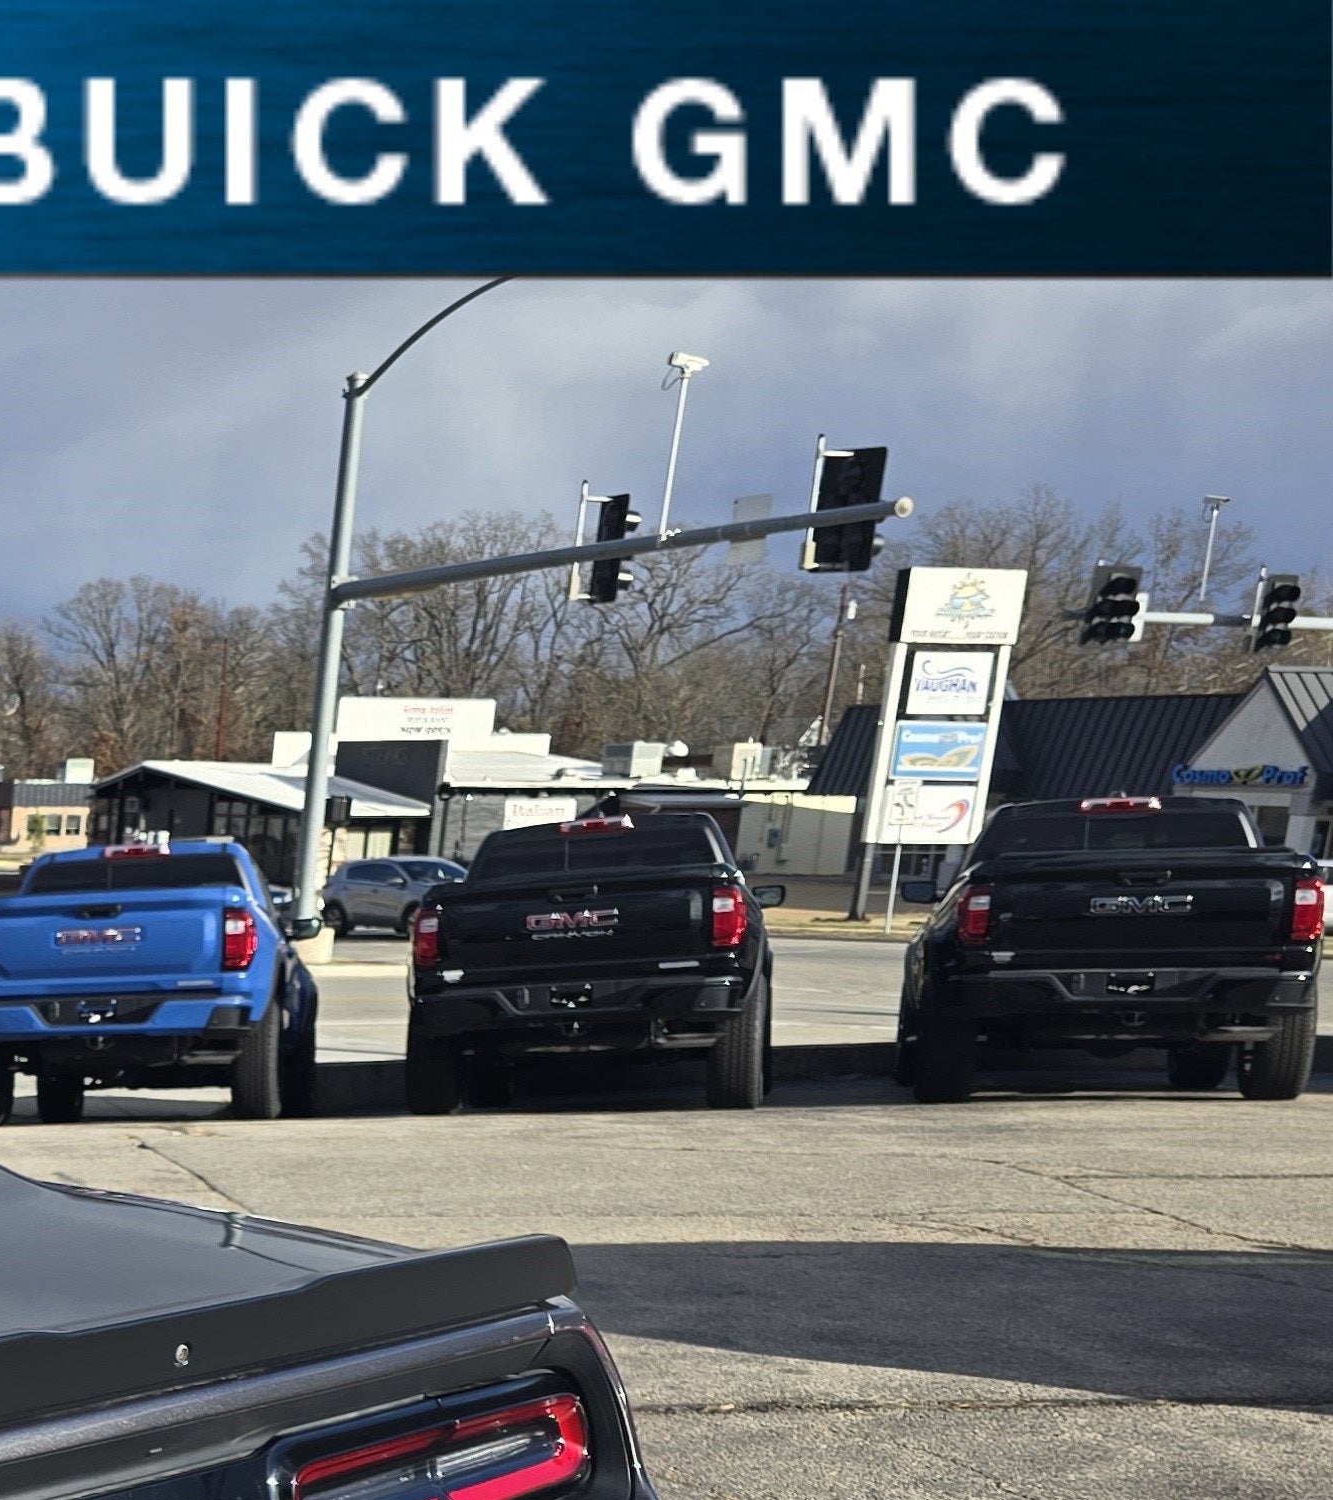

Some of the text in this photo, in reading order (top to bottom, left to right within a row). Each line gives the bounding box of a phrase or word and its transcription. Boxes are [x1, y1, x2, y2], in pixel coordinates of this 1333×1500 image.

[901, 730, 940, 743] Cosmo
[1171, 763, 1309, 785] Cosmo Prof
[1090, 894, 1194, 915] GMC
[526, 907, 619, 931] GMC
